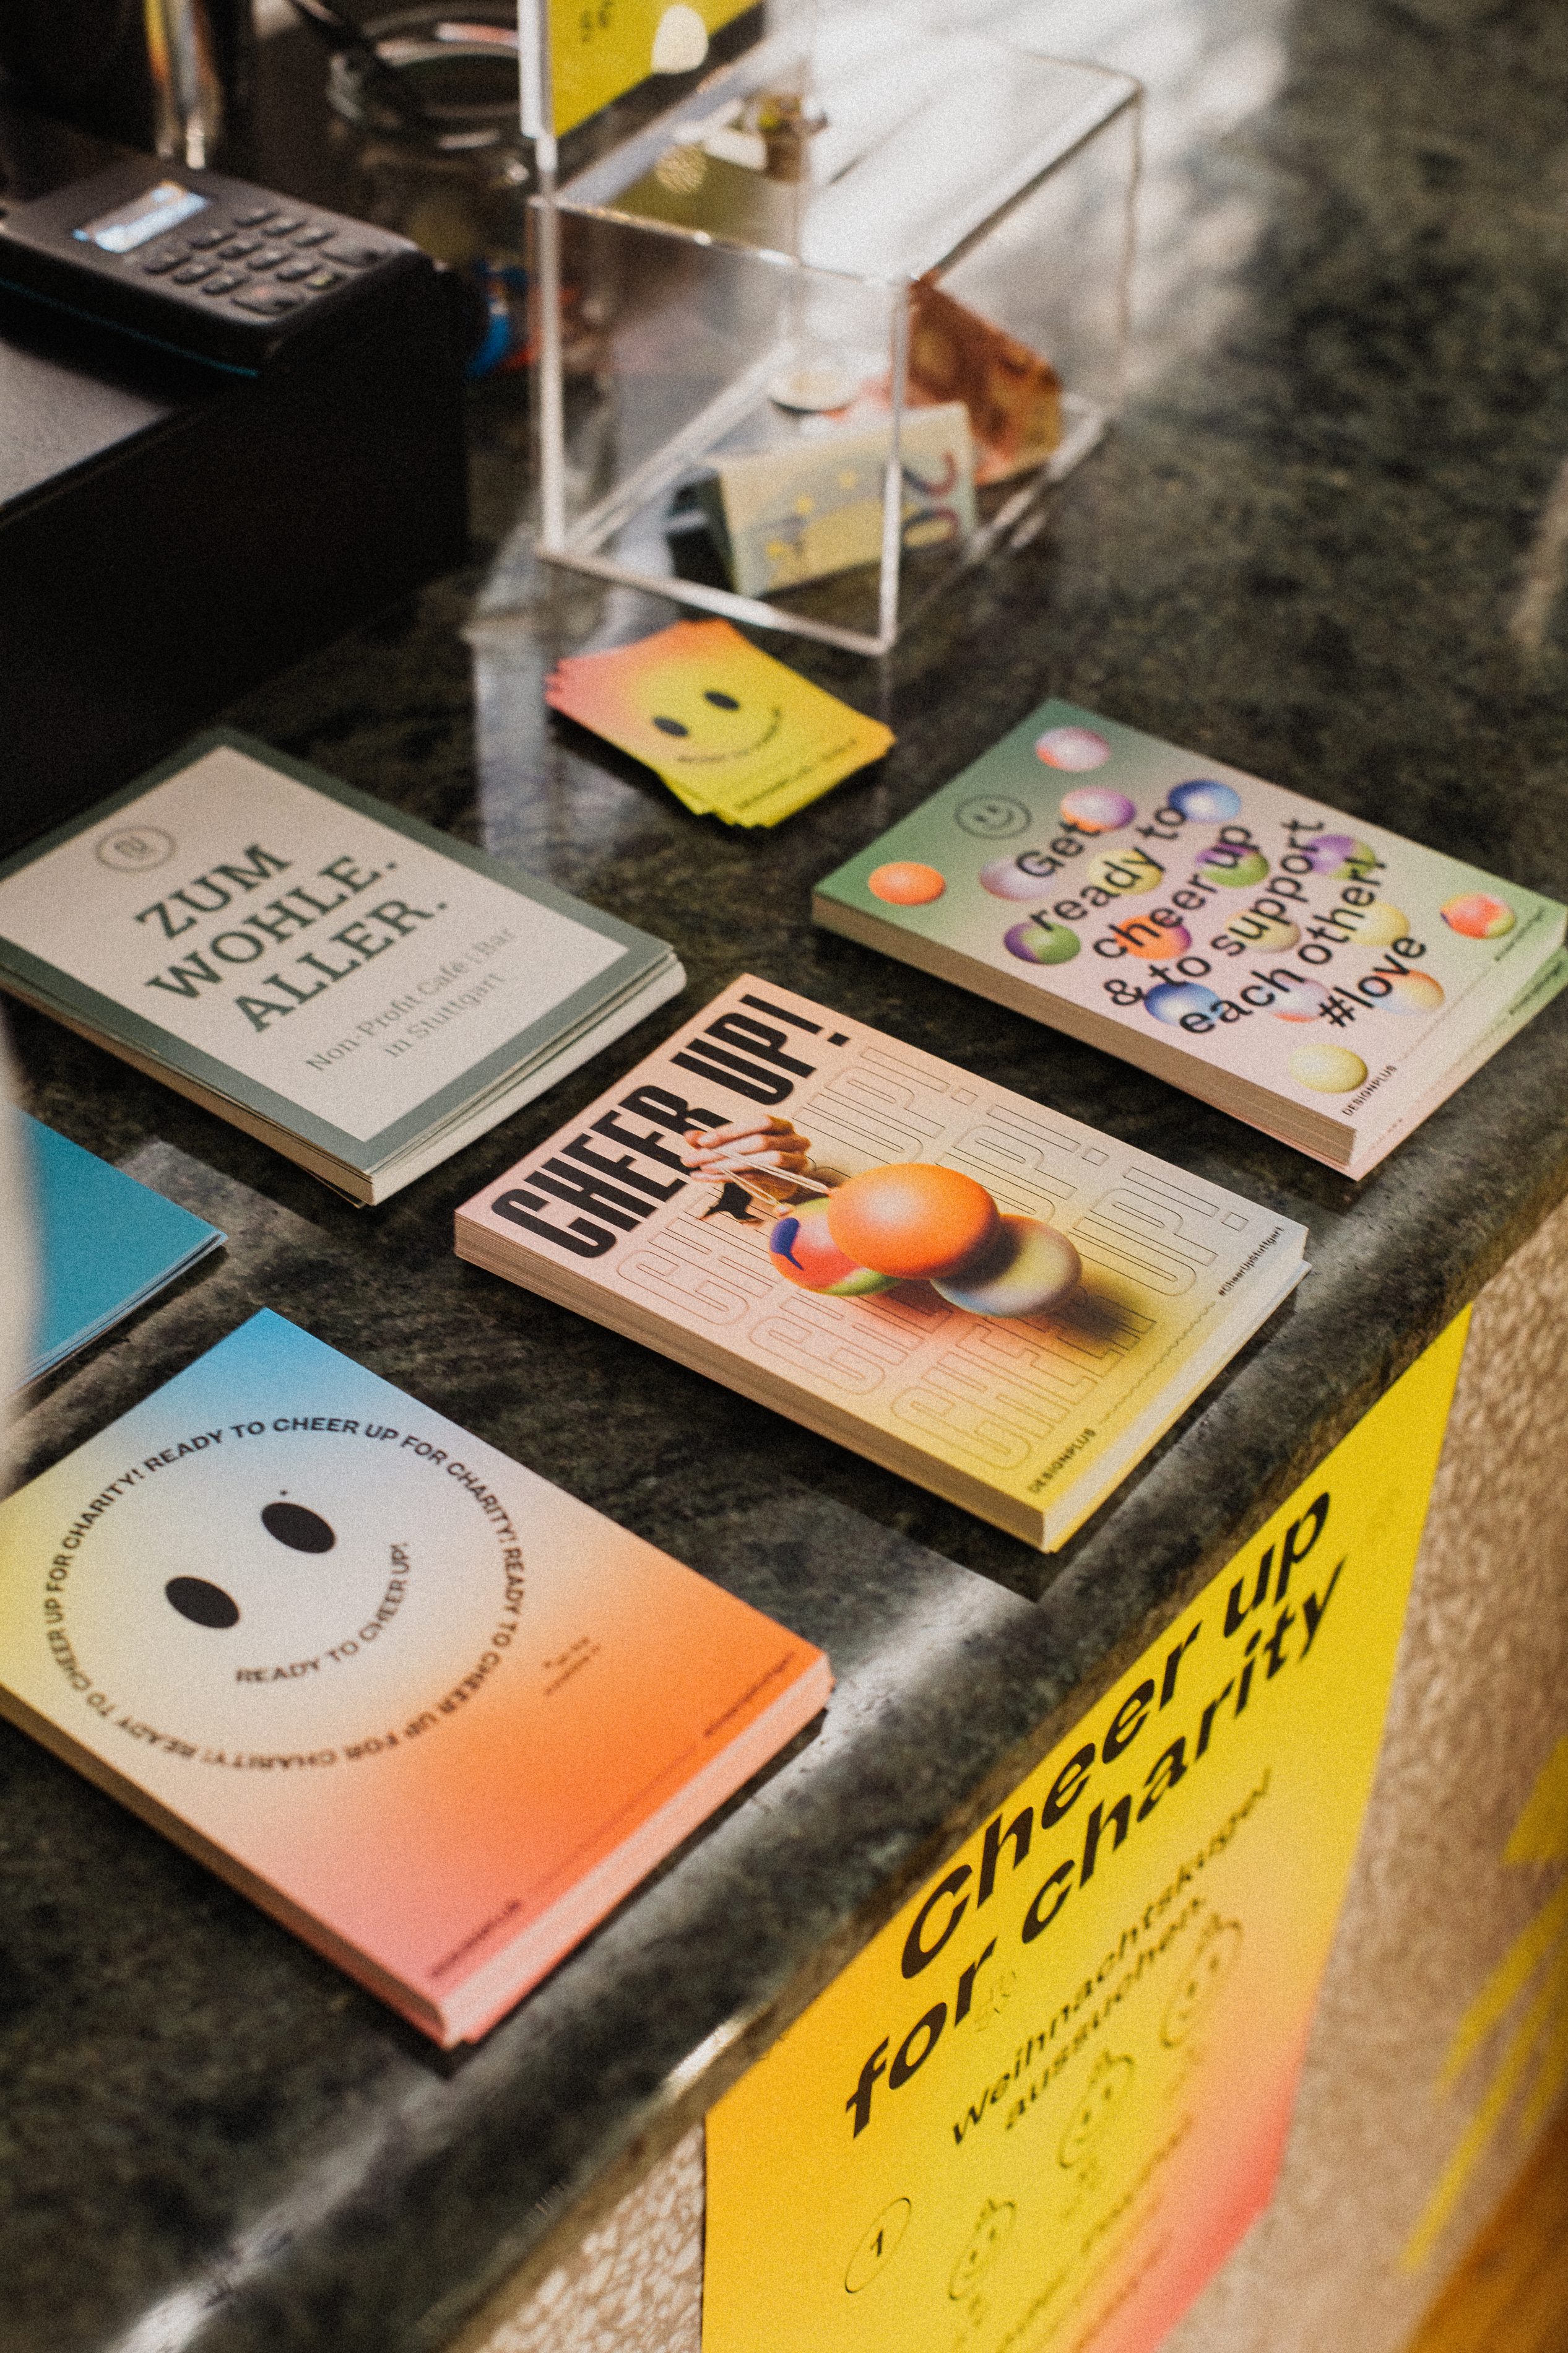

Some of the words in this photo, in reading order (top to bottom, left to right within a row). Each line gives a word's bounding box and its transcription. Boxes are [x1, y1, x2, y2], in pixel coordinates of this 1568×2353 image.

[1015, 817, 1101, 878] Get
[1031, 844, 1164, 933] ready
[1137, 805, 1187, 843] to
[135, 843, 293, 939] ZUM
[145, 855, 397, 999] WOHLE.
[1093, 871, 1217, 961] cheer
[1204, 824, 1260, 869] up
[1102, 978, 1148, 1006] &
[1149, 956, 1211, 987] to
[1211, 816, 1325, 957] support
[235, 899, 448, 1033] ALLER.
[1179, 966, 1305, 1035] each
[1298, 856, 1387, 965] other!
[1319, 936, 1427, 1028] #love
[306, 994, 423, 1071] Non-Profit
[385, 1040, 414, 1058] in
[491, 1085, 733, 1258] CHEER
[670, 993, 851, 1105] UP!
[144, 1429, 223, 1472] READY
[230, 1421, 266, 1438] TO
[273, 1417, 360, 1434] CHEER
[365, 1424, 399, 1441] UP
[401, 1435, 448, 1466] FOR
[62, 1468, 145, 1549] CHARITY!
[447, 1461, 518, 1543] CHARITY!
[44, 1597, 64, 1625] UP
[46, 1553, 74, 1592] FOR
[503, 1547, 526, 1615] READY
[236, 1657, 320, 1682] READY
[326, 1640, 360, 1661] TO
[358, 1579, 409, 1641] CHEER
[492, 1621, 518, 1648] TO
[438, 1651, 501, 1715] CHEER
[901, 1620, 1203, 1980] Cheer
[1223, 1492, 1330, 1639] up
[846, 1937, 997, 2140] for
[1021, 1555, 1347, 1946] charity
